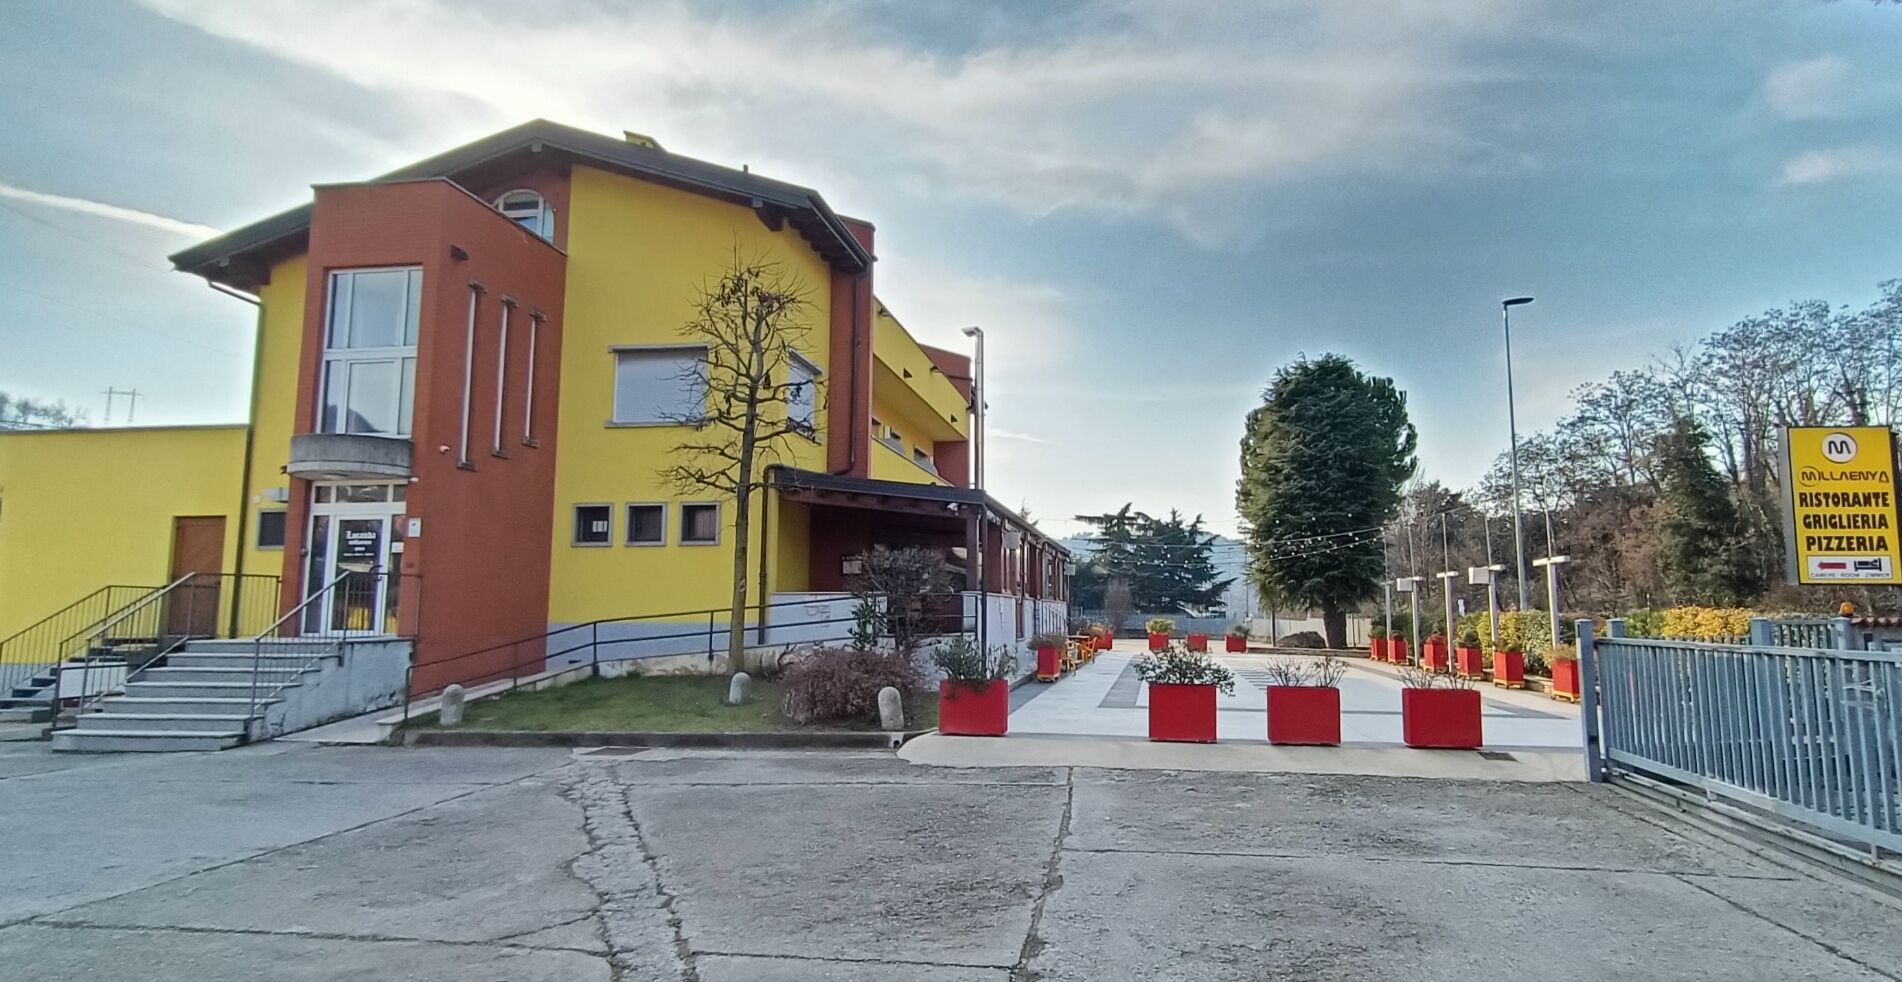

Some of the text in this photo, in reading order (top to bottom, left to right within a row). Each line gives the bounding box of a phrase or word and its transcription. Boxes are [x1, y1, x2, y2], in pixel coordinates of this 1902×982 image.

[1799, 492, 1889, 508] RISTORANTE
[1802, 513, 1889, 529] GRIGLIERIA
[1805, 536, 1889, 551] PIZZERIA
